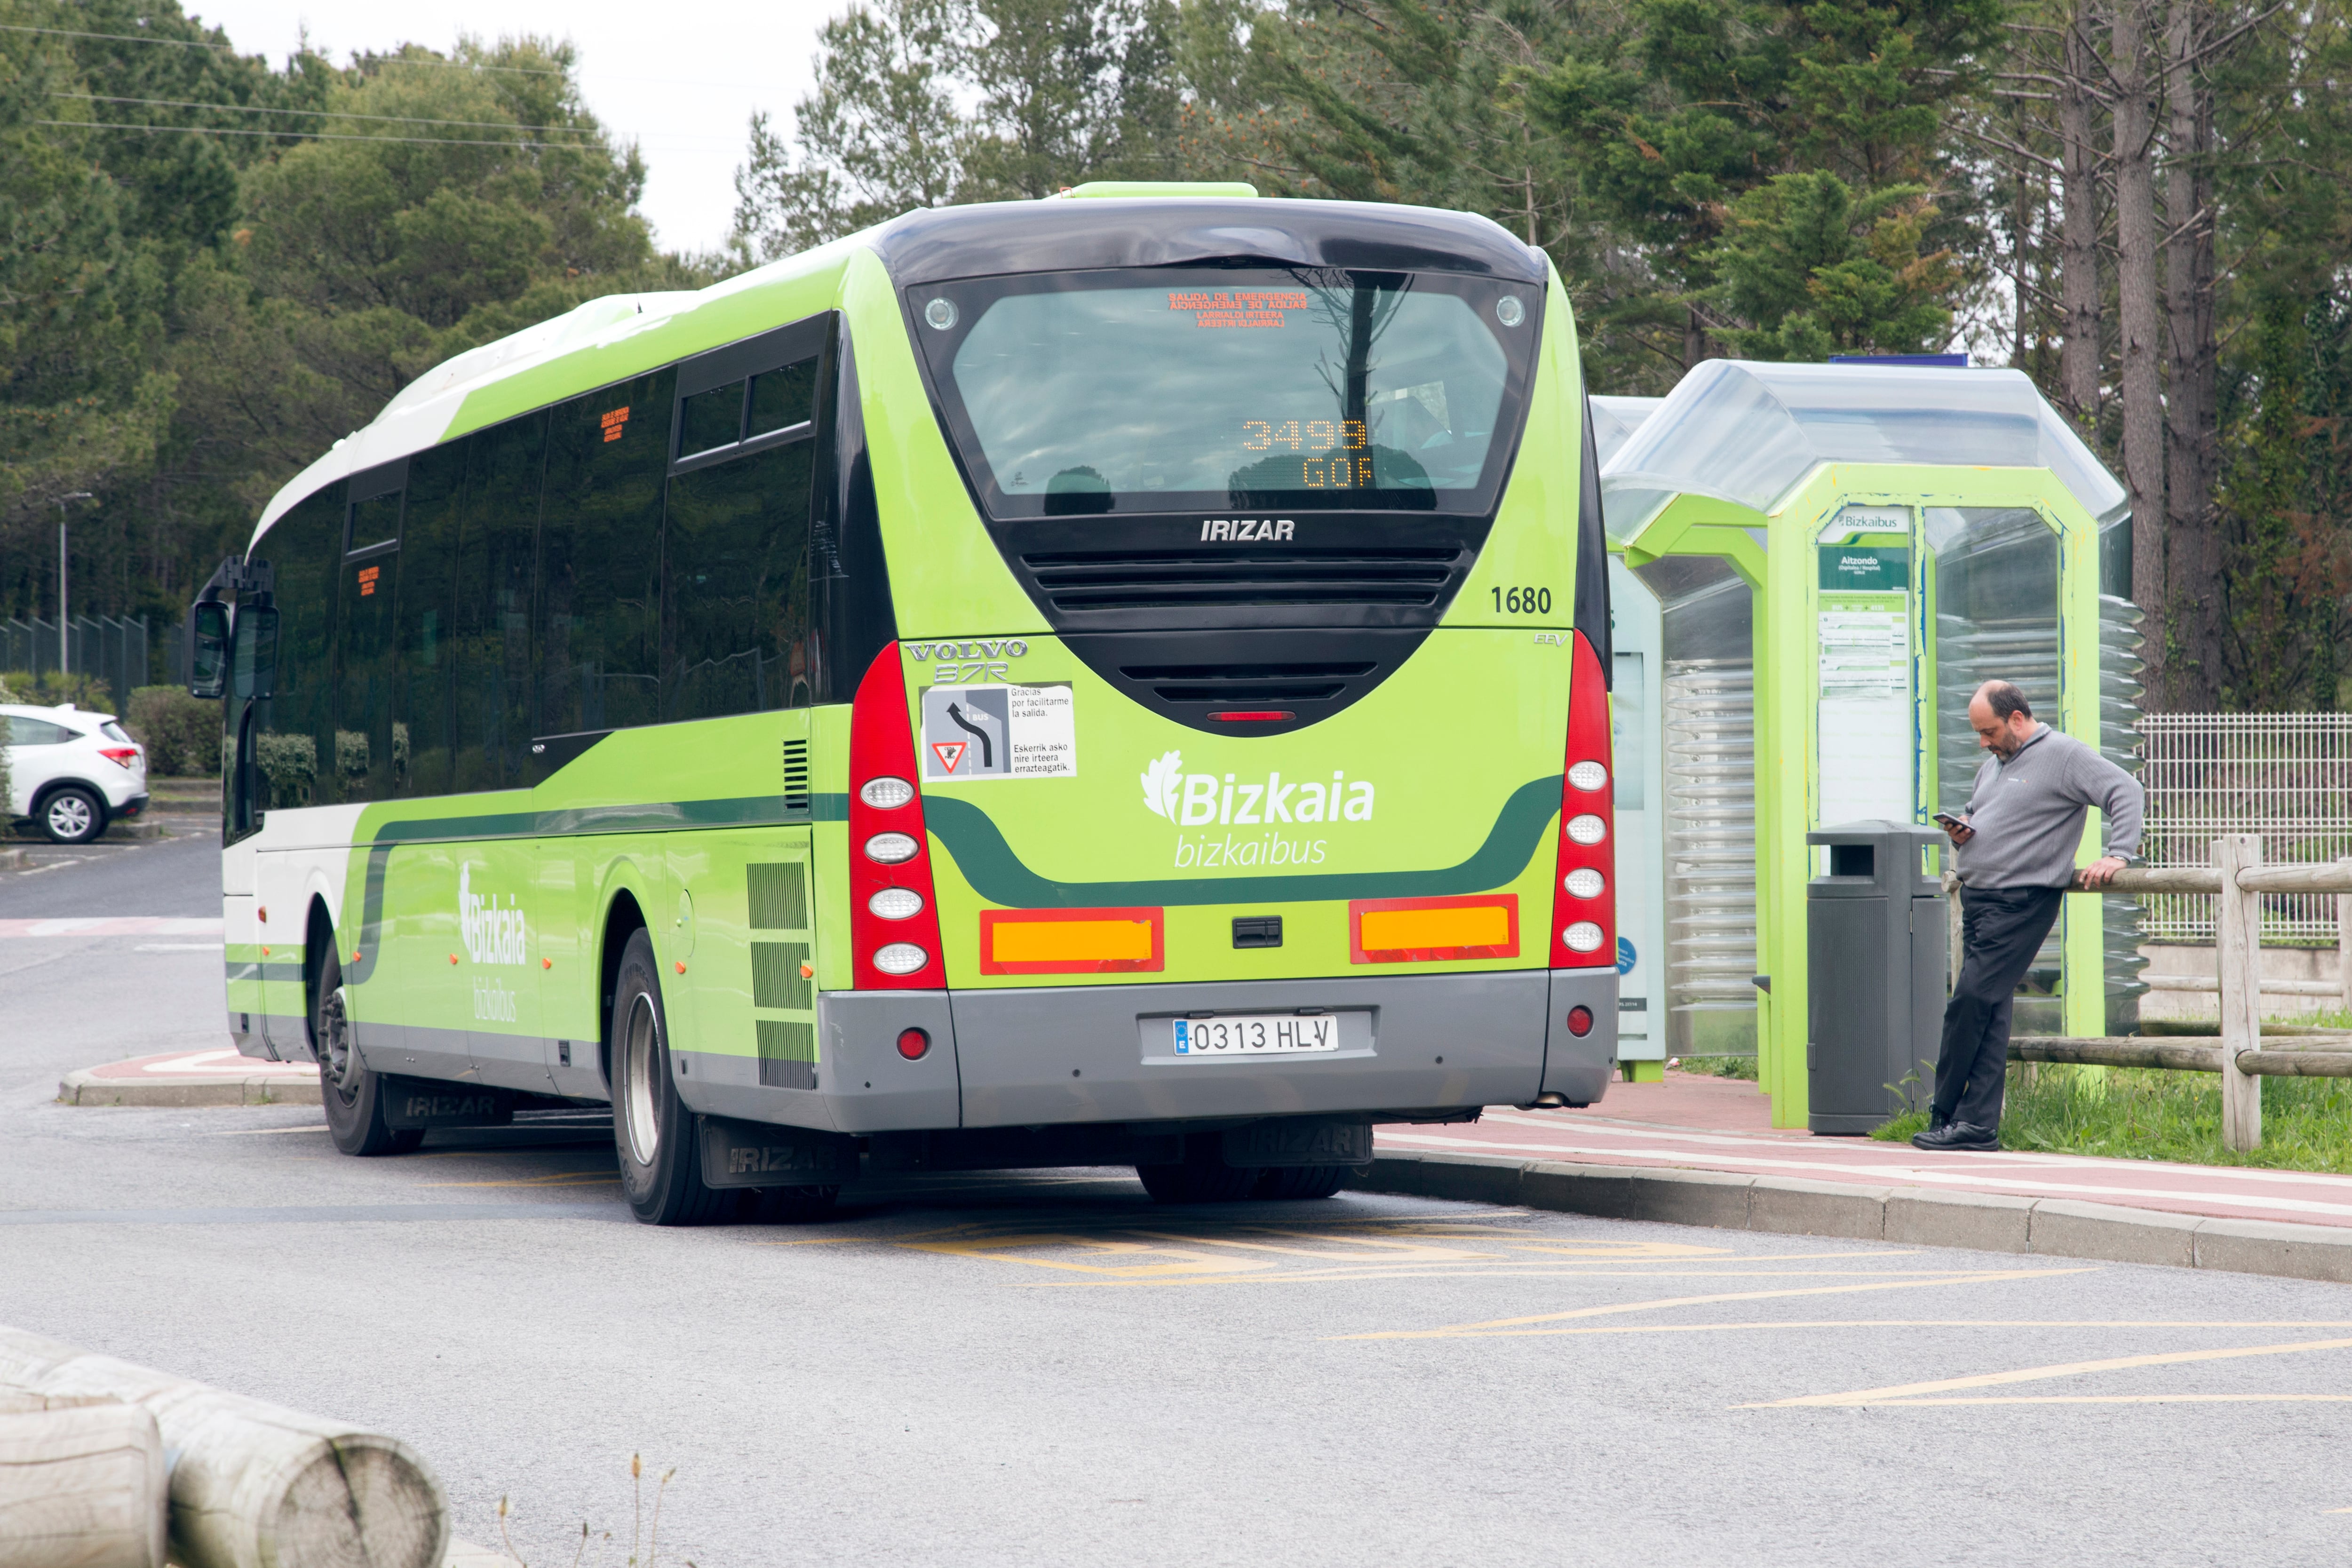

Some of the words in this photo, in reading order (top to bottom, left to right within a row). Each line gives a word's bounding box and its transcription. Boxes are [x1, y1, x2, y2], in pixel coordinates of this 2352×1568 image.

[1168, 293, 1209, 302] SALIDA
[1213, 293, 1229, 301] DE
[1234, 293, 1306, 301] EMERGENCIA
[1243, 421, 1366, 450] 3499
[1846, 516, 1897, 527] Bizkaibus
[1200, 520, 1295, 541] IRIZAR
[1841, 556, 1878, 565] Aitzondo
[1492, 587, 1551, 614] 1680
[1534, 633, 1569, 647] EEV
[905, 639, 1028, 661] VOLVO
[933, 661, 1009, 683] B7R
[1011, 688, 1041, 696] Gracias
[1012, 699, 1025, 708] por
[1027, 697, 1069, 707] facilitarme
[1012, 709, 1019, 717] la
[1022, 708, 1048, 717] salida.
[1014, 743, 1046, 753] Eskerrik
[1049, 742, 1068, 751] asko
[1015, 754, 1029, 763] nire
[1032, 754, 1058, 762] irteera
[1015, 763, 1070, 773] errazteagatik.
[1180, 771, 1375, 826] Bizkaia
[1175, 831, 1327, 868] bizkaibus
[470, 893, 526, 965] Bizkaia
[473, 975, 516, 1022] bizkaibus
[1194, 1023, 1266, 1050] 0313
[1277, 1020, 1328, 1047] HLV
